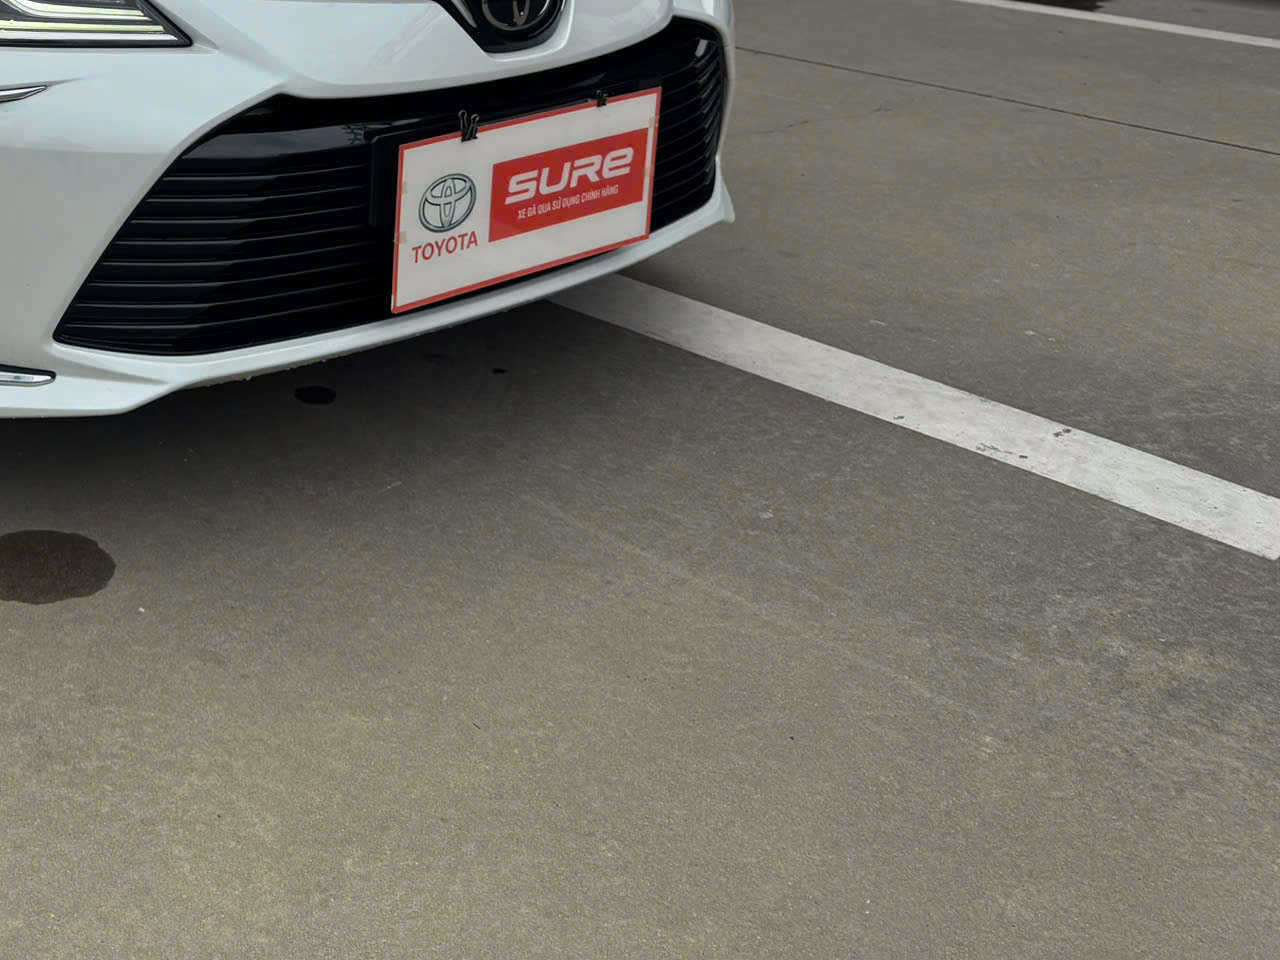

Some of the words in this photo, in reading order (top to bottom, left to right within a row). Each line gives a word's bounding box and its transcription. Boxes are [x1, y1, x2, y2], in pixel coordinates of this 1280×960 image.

[504, 147, 634, 205] SURE
[517, 208, 526, 220] XE
[538, 202, 551, 216] QUA
[411, 230, 479, 264] TOYOTA
